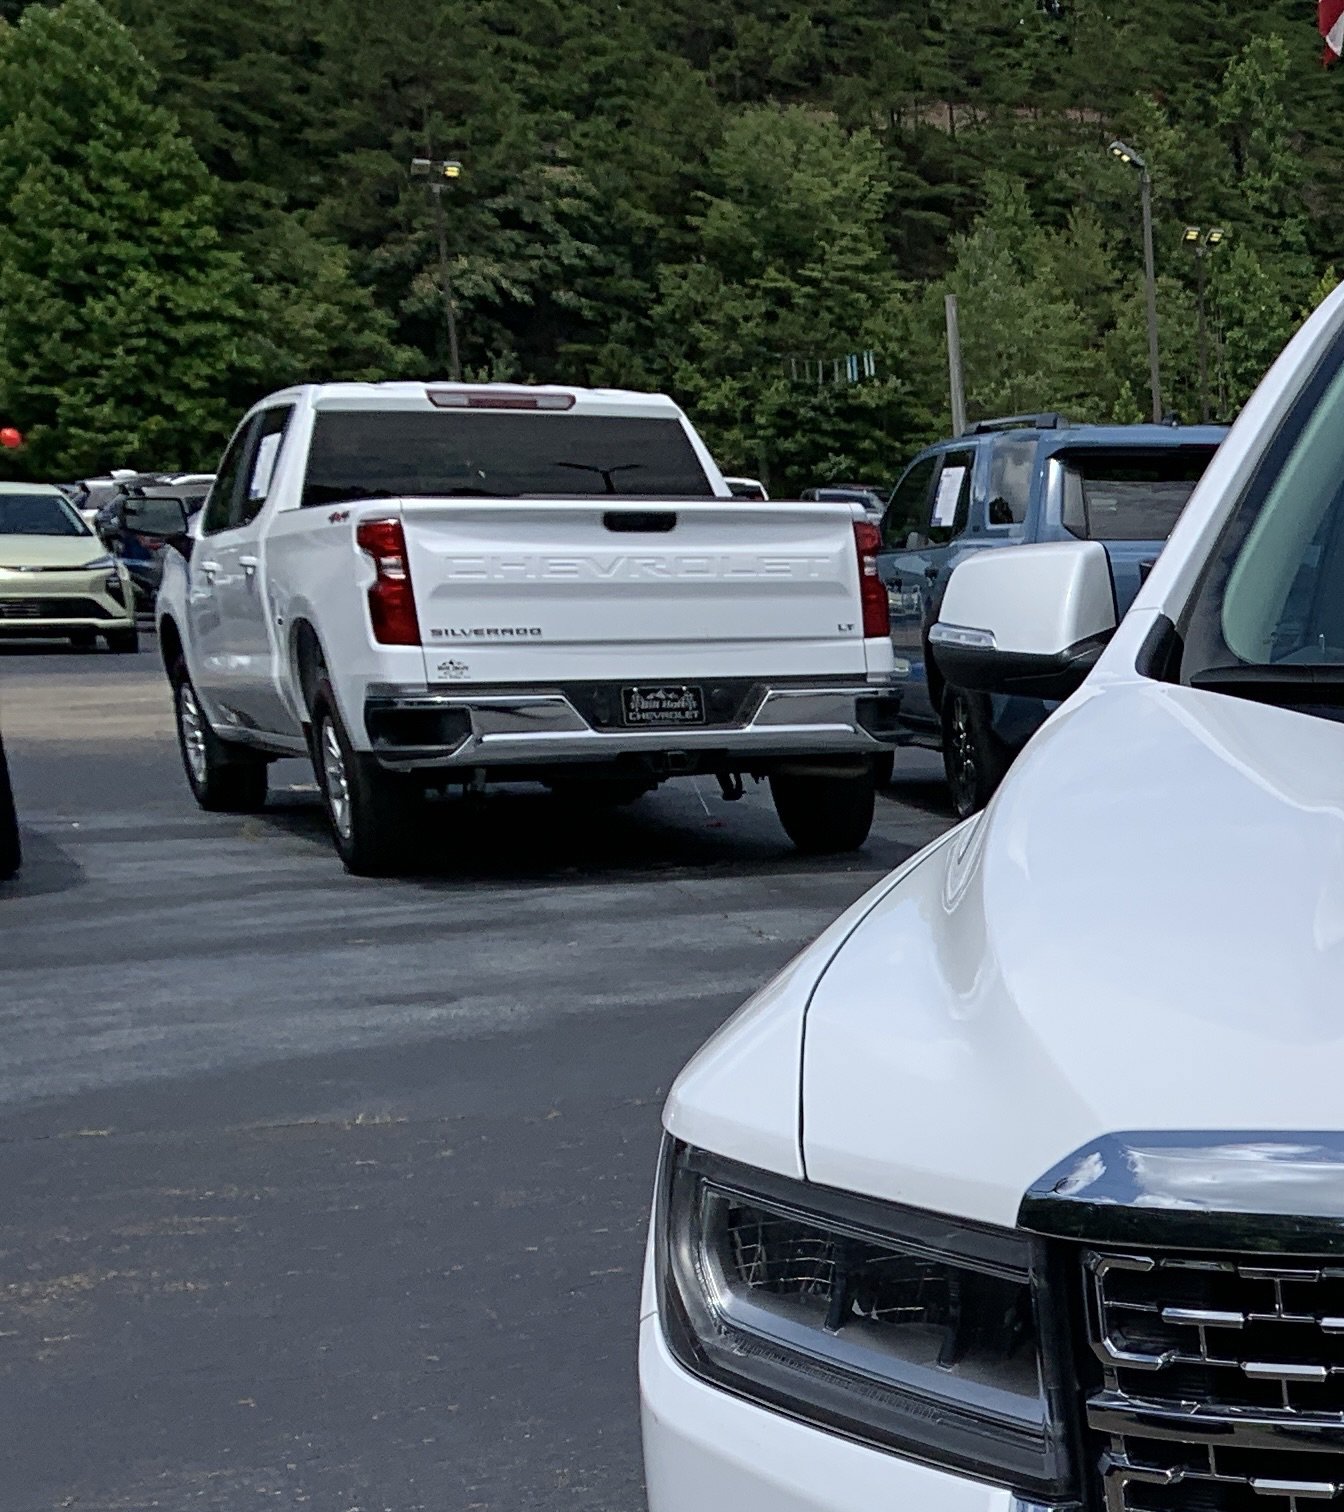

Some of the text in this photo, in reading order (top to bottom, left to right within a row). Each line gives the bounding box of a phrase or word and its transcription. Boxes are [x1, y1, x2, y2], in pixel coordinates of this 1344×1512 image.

[446, 556, 833, 579] CHEVROLET
[430, 627, 543, 638] SILVERADO
[837, 623, 855, 632] LT
[629, 710, 699, 721] CHEVROLET
